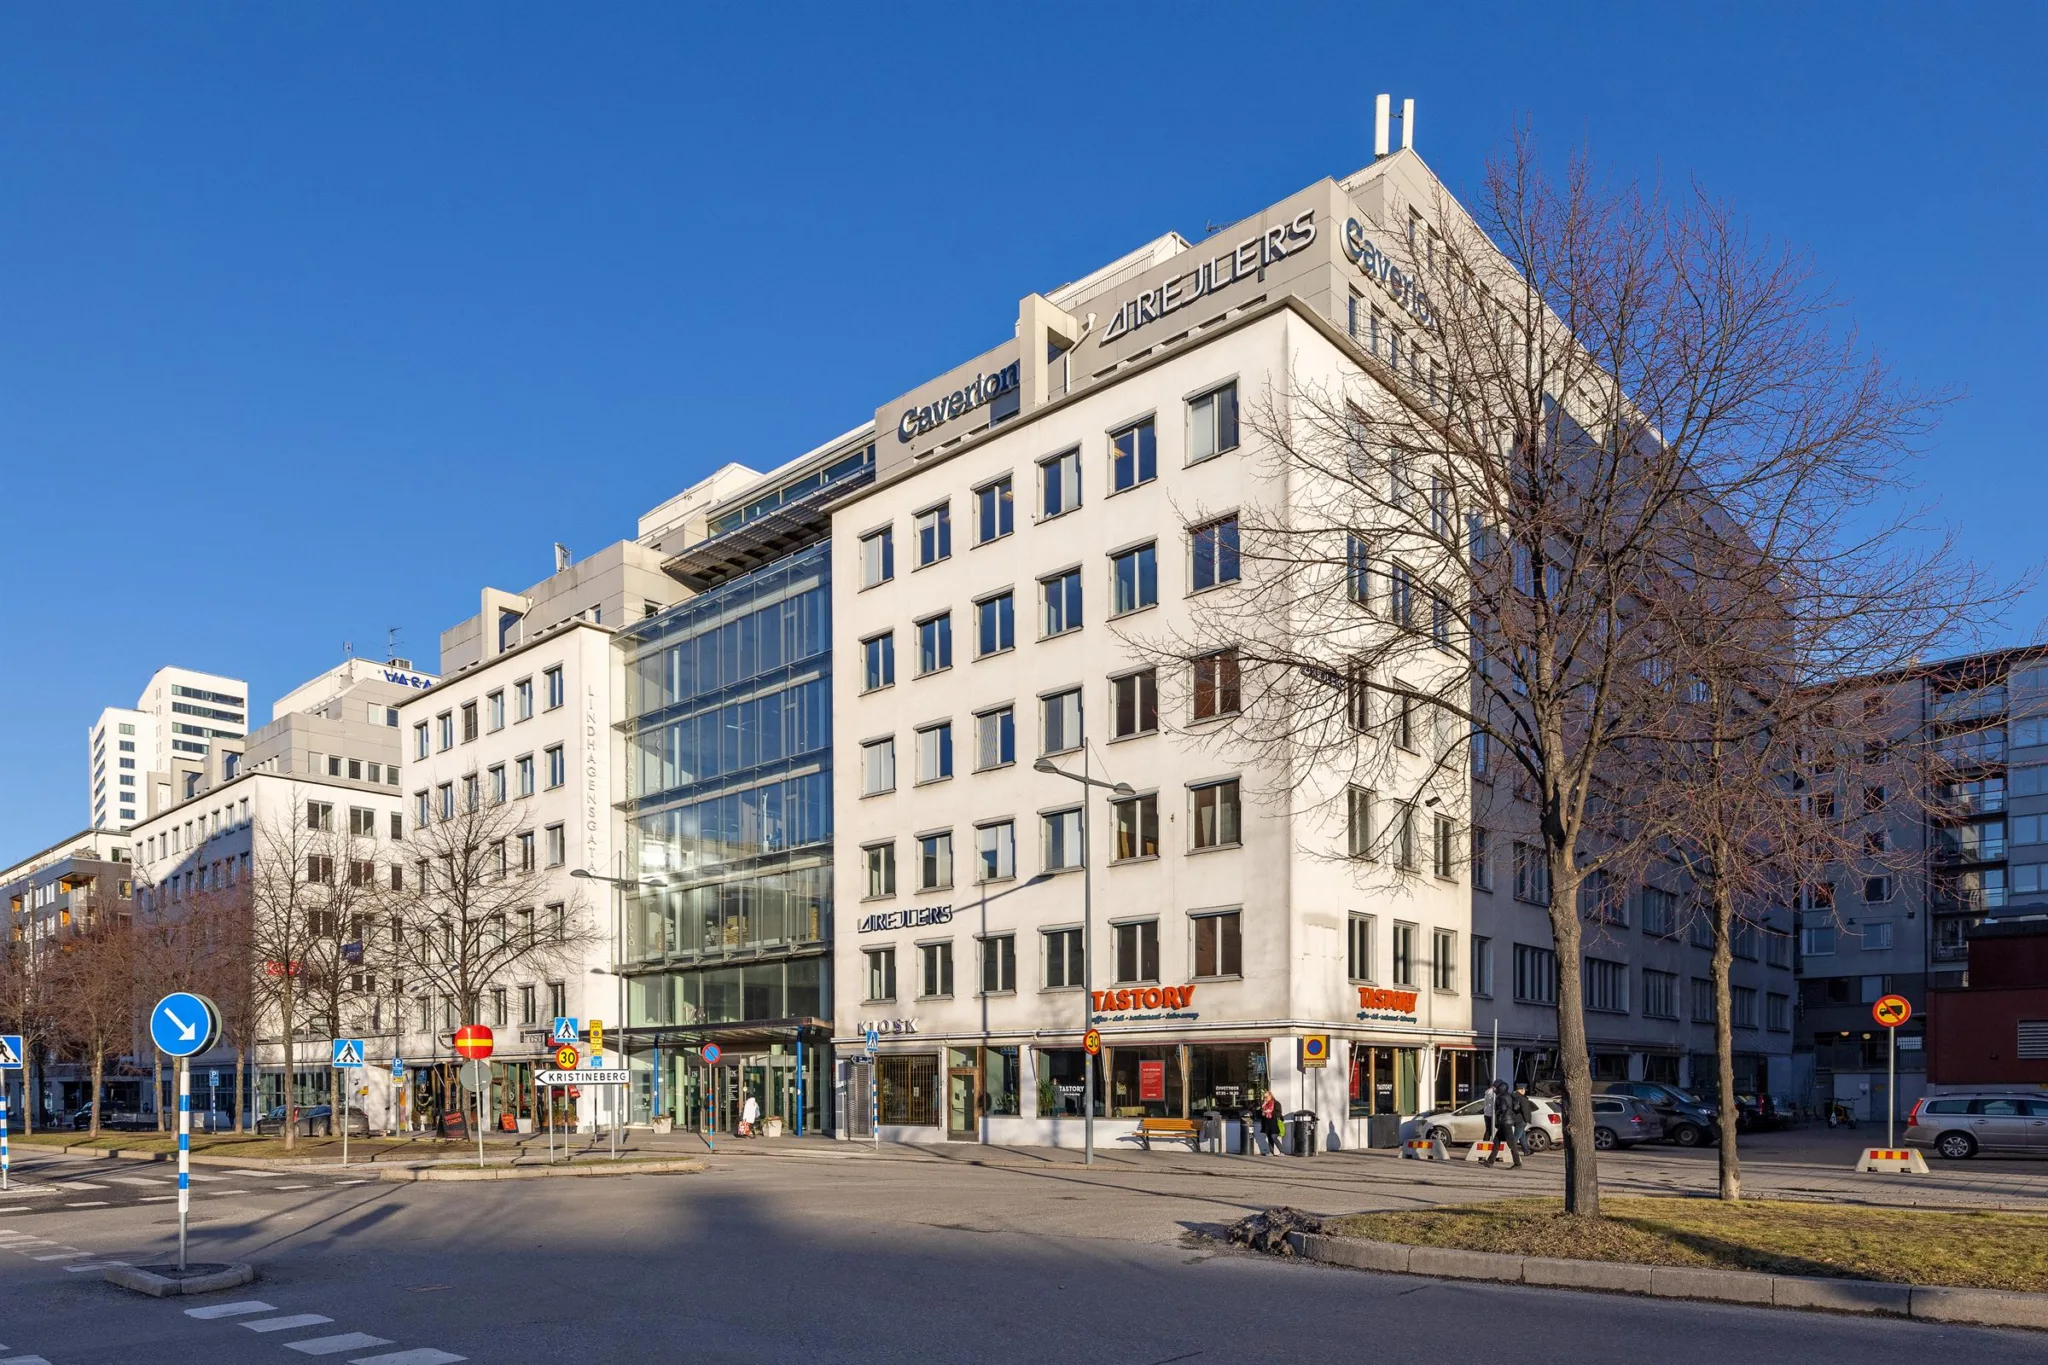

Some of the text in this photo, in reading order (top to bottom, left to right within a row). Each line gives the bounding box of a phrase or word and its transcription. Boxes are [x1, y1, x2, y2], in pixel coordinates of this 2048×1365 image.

[898, 362, 1020, 443] Caverion
[1091, 984, 1196, 1012] TASTORY
[857, 1018, 918, 1036] KIOSK
[1088, 1035, 1099, 1048] 30
[560, 1051, 576, 1064] 30
[548, 1072, 627, 1082] KRISTINEBERG
